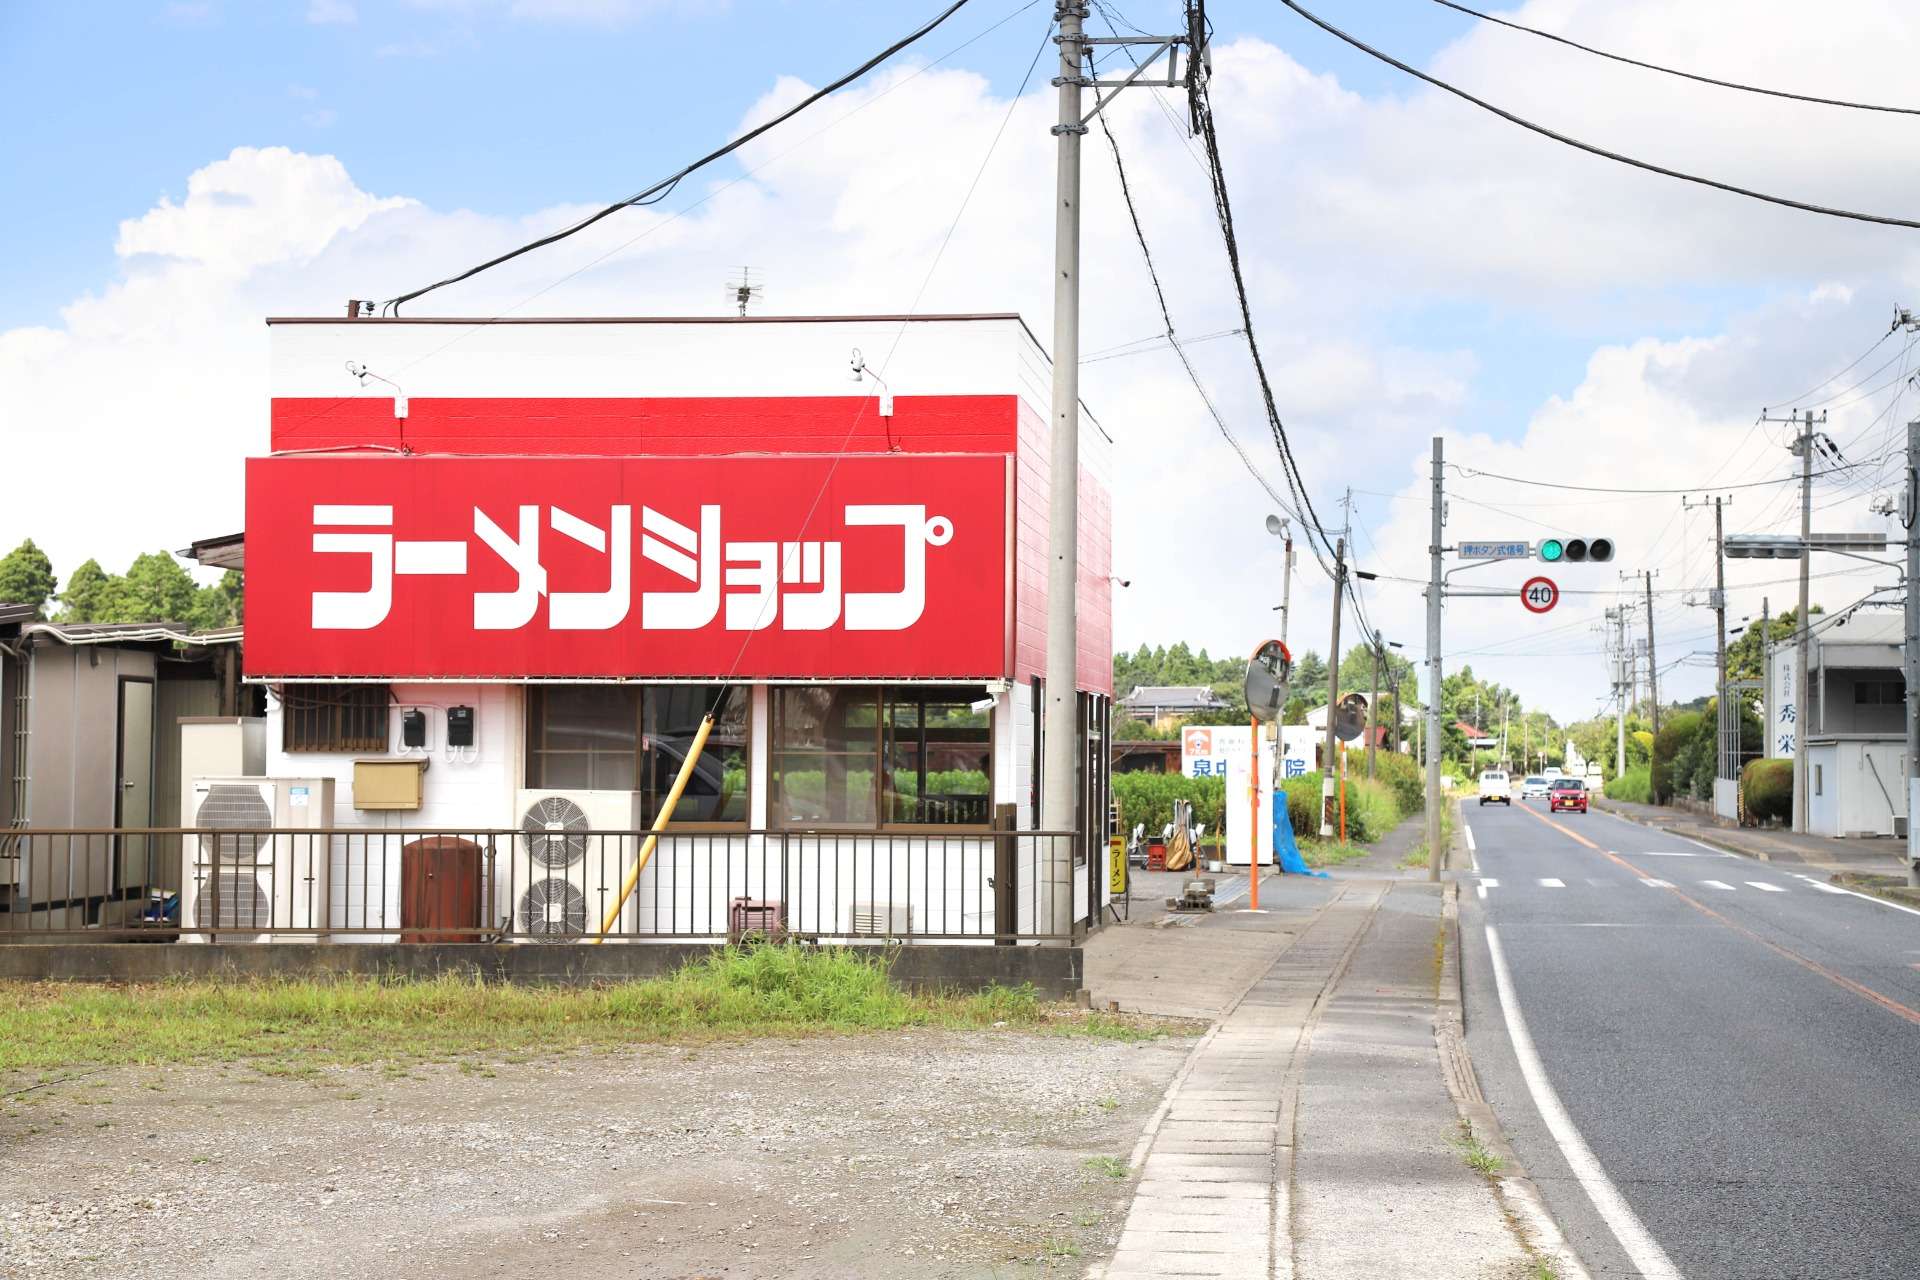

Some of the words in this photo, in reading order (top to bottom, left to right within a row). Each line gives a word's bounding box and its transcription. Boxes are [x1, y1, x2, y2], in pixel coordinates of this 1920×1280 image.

[1463, 543, 1525, 556] 押ボタン式信号
[311, 504, 954, 631] ラーメンショップ
[1529, 587, 1551, 603] 40
[1111, 849, 1121, 887] ラーメン
